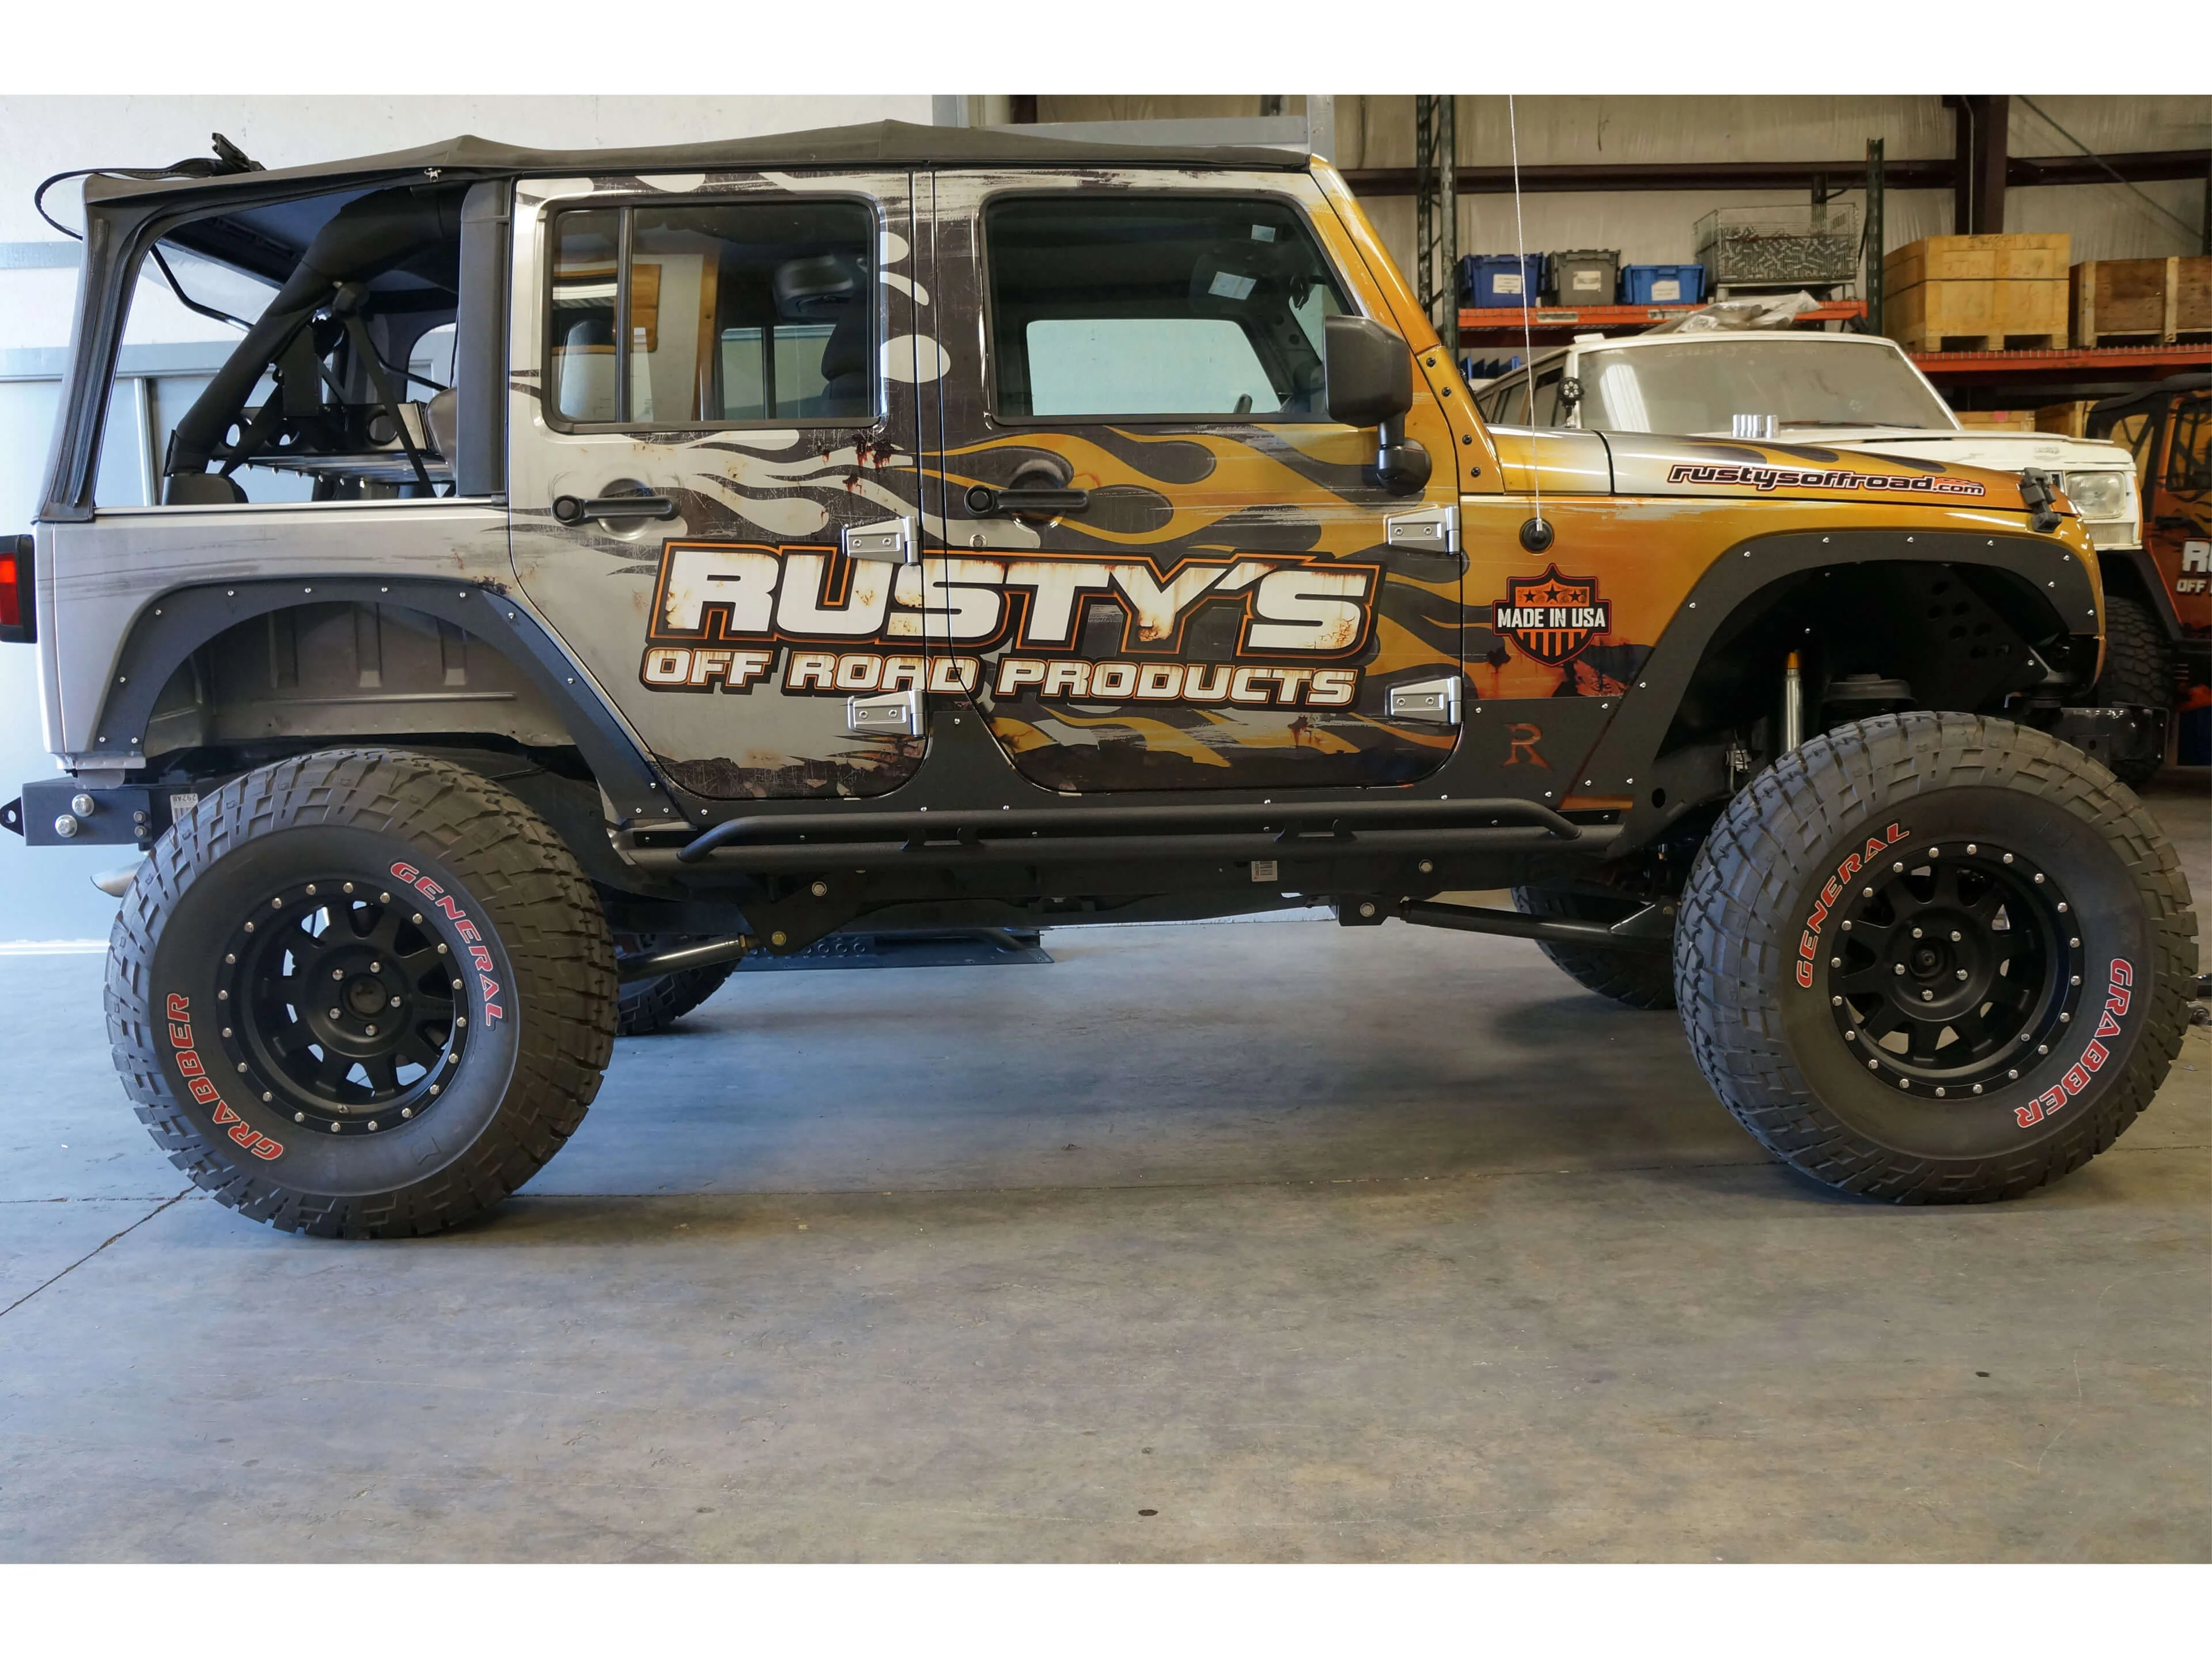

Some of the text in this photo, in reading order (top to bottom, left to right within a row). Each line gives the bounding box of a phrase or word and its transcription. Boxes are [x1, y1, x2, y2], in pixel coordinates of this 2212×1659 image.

[1668, 465, 1984, 496] rustysoffroad.com
[666, 550, 1368, 651] RUSTY'S
[1498, 608, 1605, 628] MADE IN USA
[2177, 579, 2207, 593] OFF
[645, 649, 1354, 704] OFF ROAD PRODUCTS
[1501, 722, 1552, 771] R
[1796, 822, 1910, 988] GENERAL
[390, 862, 503, 1027] GENERAL
[166, 993, 283, 1160] GRABBER
[2013, 958, 2133, 1128] GRABBER
